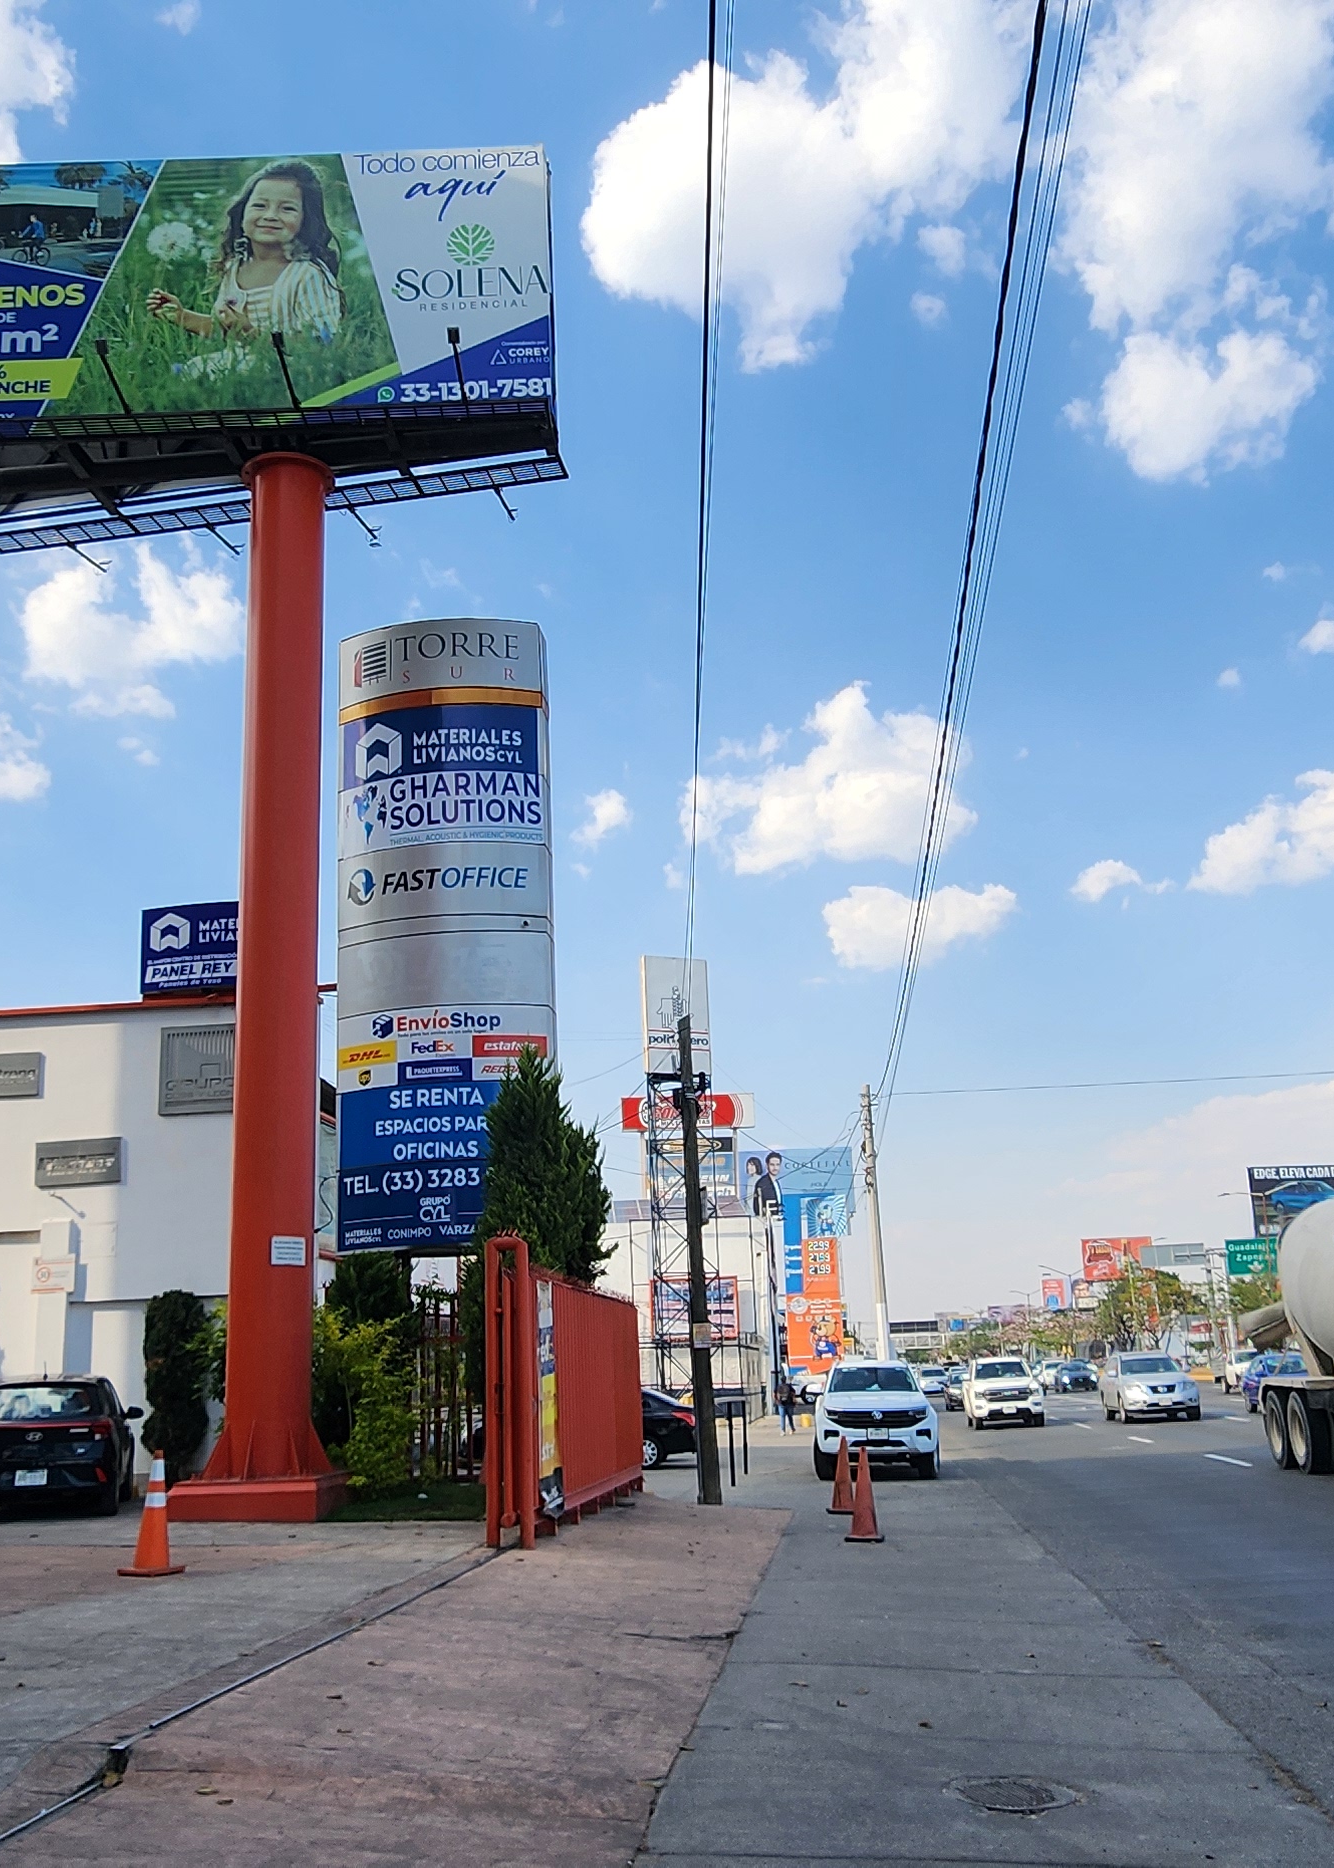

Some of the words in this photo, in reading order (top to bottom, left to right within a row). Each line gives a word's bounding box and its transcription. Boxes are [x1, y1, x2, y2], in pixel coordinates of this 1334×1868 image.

[353, 152, 415, 175] Todo
[422, 148, 540, 172] comienza
[404, 169, 506, 222] aquí
[396, 264, 548, 302] SOLENA
[419, 299, 528, 312] RESIDENCIAL
[508, 346, 549, 357] COREY
[509, 356, 550, 365] URBANO
[400, 376, 552, 403] 33-1301-7581
[394, 631, 520, 662] TORRE
[402, 665, 517, 684] SUR
[412, 728, 522, 747] MATERIALES
[389, 771, 541, 803] GHARMAN
[390, 798, 543, 830] SOLUTIONS
[425, 832, 462, 842] ACOUSTIC
[469, 831, 504, 840] HYGIENIC
[505, 831, 544, 842] PRODUCTS
[198, 918, 238, 932] MATE
[198, 931, 238, 944] LIVIA
[151, 964, 197, 979] PANEL
[201, 961, 234, 975] REY
[397, 1010, 501, 1032] EnvíoShop
[348, 1049, 386, 1063] DHL
[411, 1040, 455, 1055] FedEx
[359, 1073, 371, 1084] ups
[389, 1090, 412, 1110] SE
[416, 1087, 484, 1106] RENTA
[375, 1117, 451, 1136] ESPACIOS
[454, 1114, 487, 1133] PAR
[393, 1141, 479, 1161] OFICINAS
[343, 1175, 379, 1196] TEL.
[382, 1168, 423, 1195] (33)
[427, 1167, 481, 1188] 3283
[1253, 1168, 1280, 1180] EDGE,
[1279, 1167, 1306, 1179] ELEVA
[1306, 1166, 1331, 1178] CADA
[419, 1195, 451, 1206] GRUPO
[419, 1205, 451, 1222] CYL
[387, 1227, 432, 1240] CONIMPO
